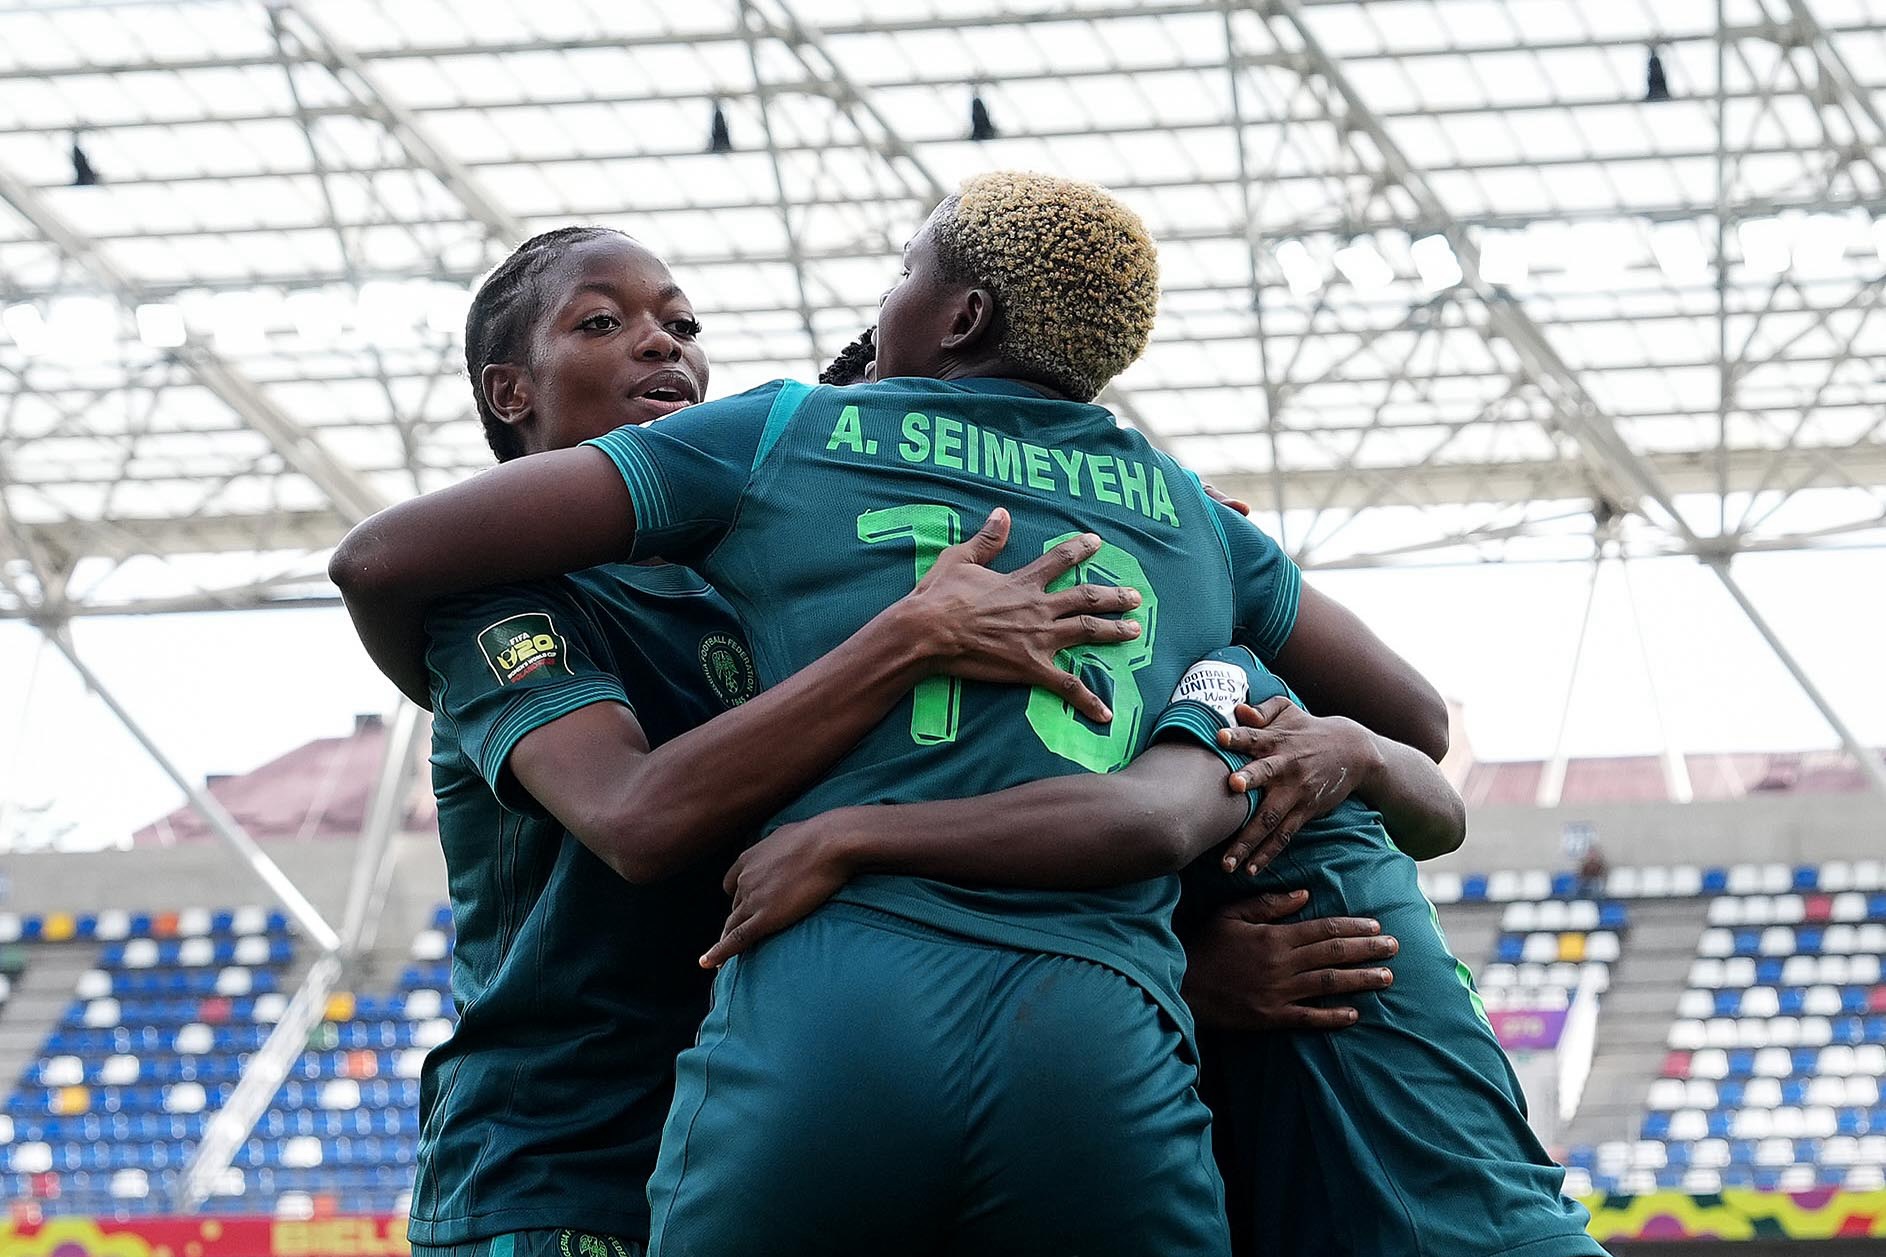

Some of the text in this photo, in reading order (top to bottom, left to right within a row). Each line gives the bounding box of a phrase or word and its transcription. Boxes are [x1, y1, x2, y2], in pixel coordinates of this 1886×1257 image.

[826, 406, 1180, 528] A. SEIMEYEHA
[509, 632, 531, 645] FIFA
[700, 635, 727, 662] FOOTBALL
[727, 638, 755, 692] FEDERATION
[857, 504, 1159, 775] 18
[1180, 678, 1236, 696] UNITES
